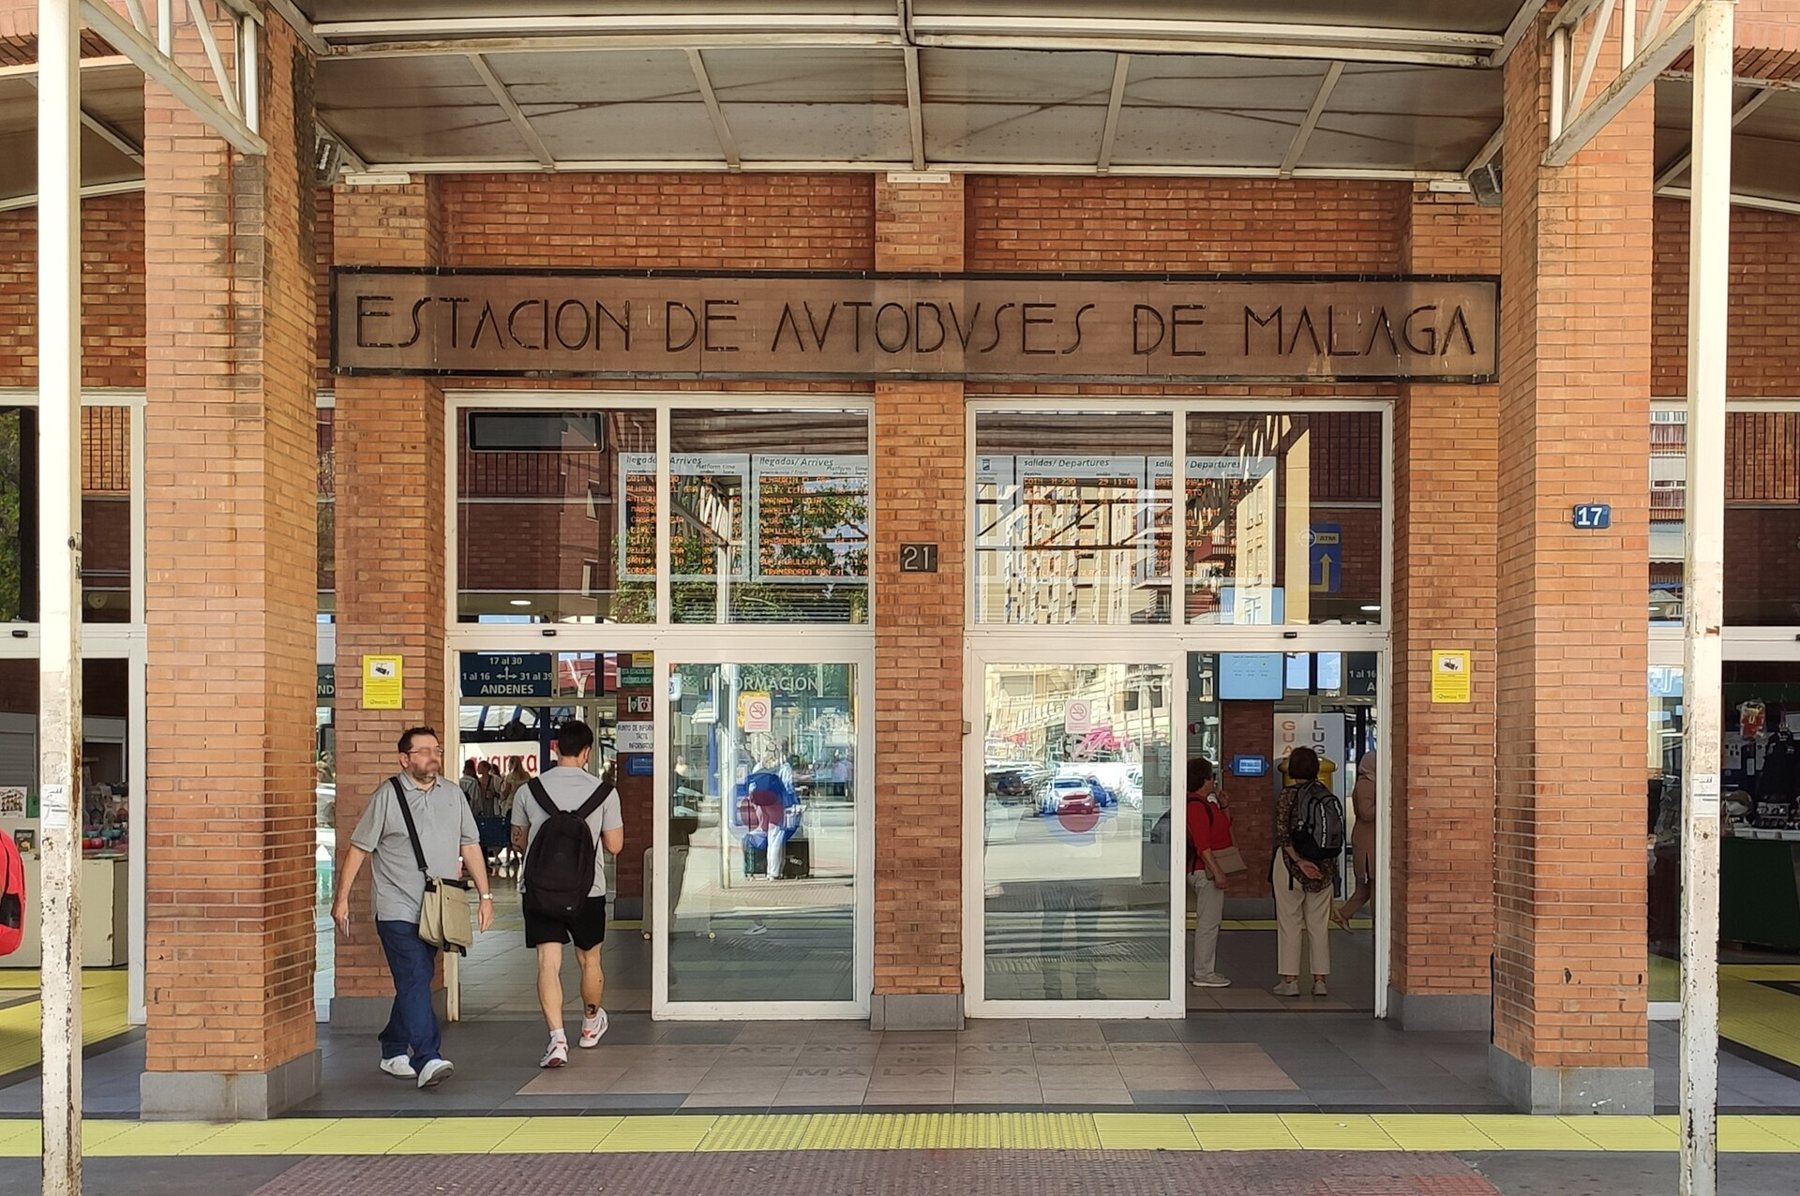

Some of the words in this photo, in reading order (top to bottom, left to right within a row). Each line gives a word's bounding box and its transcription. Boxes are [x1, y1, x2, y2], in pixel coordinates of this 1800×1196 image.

[356, 295, 631, 352] ESTACION
[666, 299, 739, 352] DE
[1134, 303, 1206, 355] DE
[1245, 304, 1476, 356] MALAGA
[1058, 459, 1110, 469] Departures
[1577, 507, 1603, 526] 17
[903, 546, 929, 570] 21
[490, 656, 500, 665] 17
[501, 656, 510, 665] al
[511, 656, 523, 665] 30
[469, 672, 478, 681] al
[480, 672, 490, 681] 16
[520, 672, 530, 681] 31
[532, 672, 541, 681] al
[480, 683, 534, 695] ANDENES
[795, 1067, 1028, 1076] MALAGA
